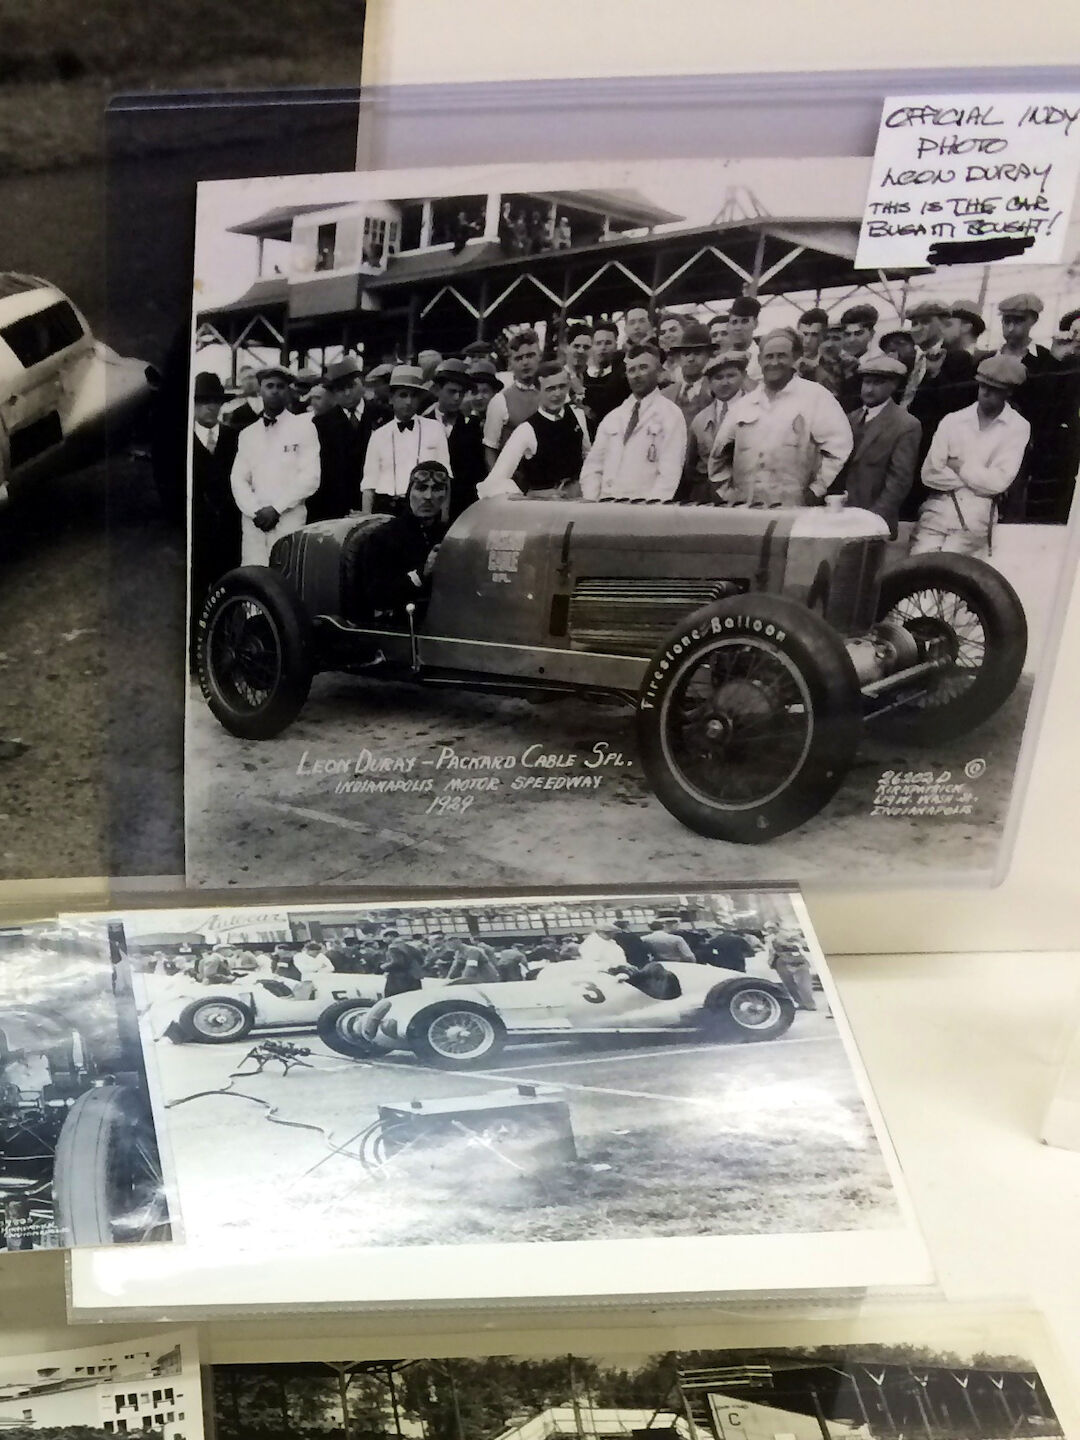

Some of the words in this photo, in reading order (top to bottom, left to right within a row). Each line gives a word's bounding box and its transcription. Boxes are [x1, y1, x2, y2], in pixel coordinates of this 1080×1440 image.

[886, 105, 1004, 128] OFFICIAL
[1018, 105, 1079, 136] INDY
[917, 134, 1008, 159] PHOTO
[881, 168, 955, 187] LEON
[966, 164, 1052, 193] DURAY
[869, 201, 911, 215] THIS
[921, 202, 943, 215] IS
[946, 197, 1002, 217] THE
[1006, 196, 1050, 213] CAR
[710, 616, 786, 642] Balloon
[335, 778, 434, 795] INDIANAPOLIS
[444, 777, 500, 792] MOTOR
[511, 775, 604, 791] SPEEDWAY
[425, 795, 475, 816] 1929
[572, 980, 606, 1004] 3
[728, 1412, 741, 1427] C
